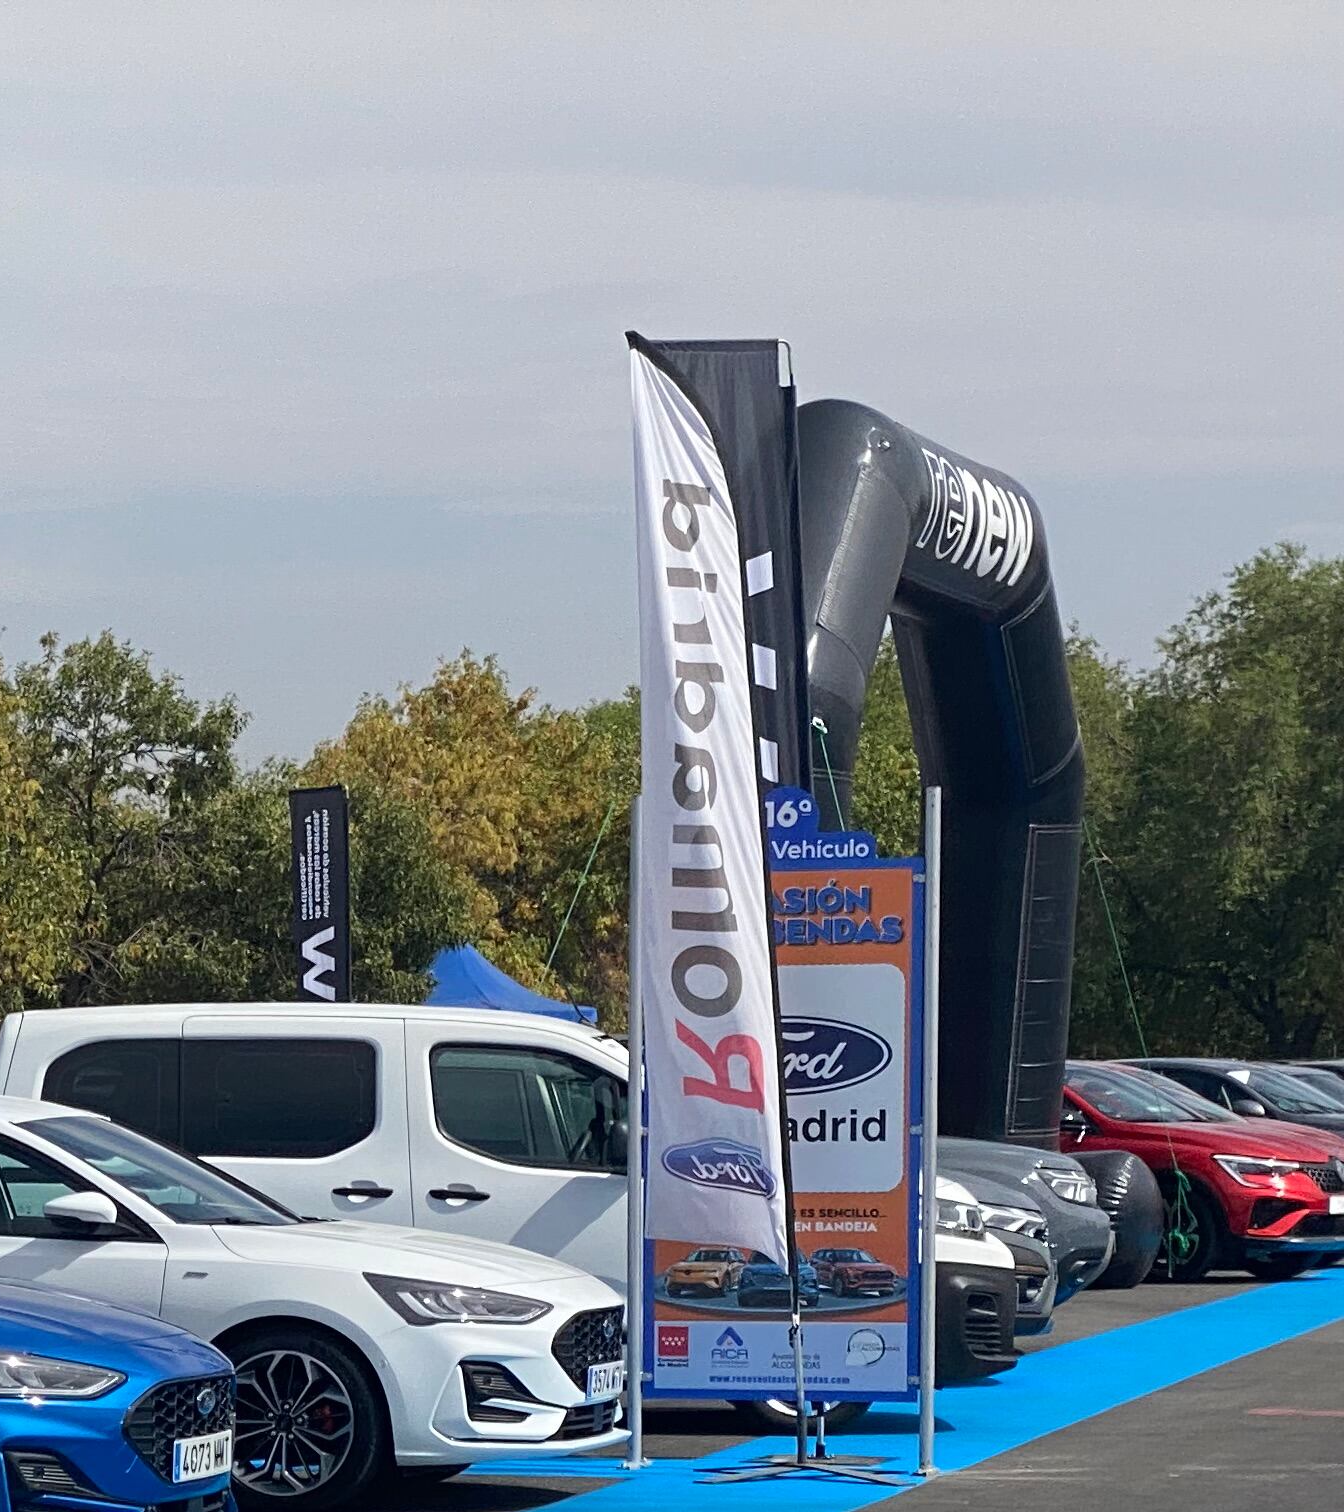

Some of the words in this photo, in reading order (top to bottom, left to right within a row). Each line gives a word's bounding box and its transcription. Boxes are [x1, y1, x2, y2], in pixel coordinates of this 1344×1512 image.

[916, 447, 1033, 586] renew
[771, 838, 870, 859] Vehículo
[800, 1208, 815, 1218] ES
[815, 1221, 878, 1232] BANDEJA
[183, 1441, 211, 1475] 4073
